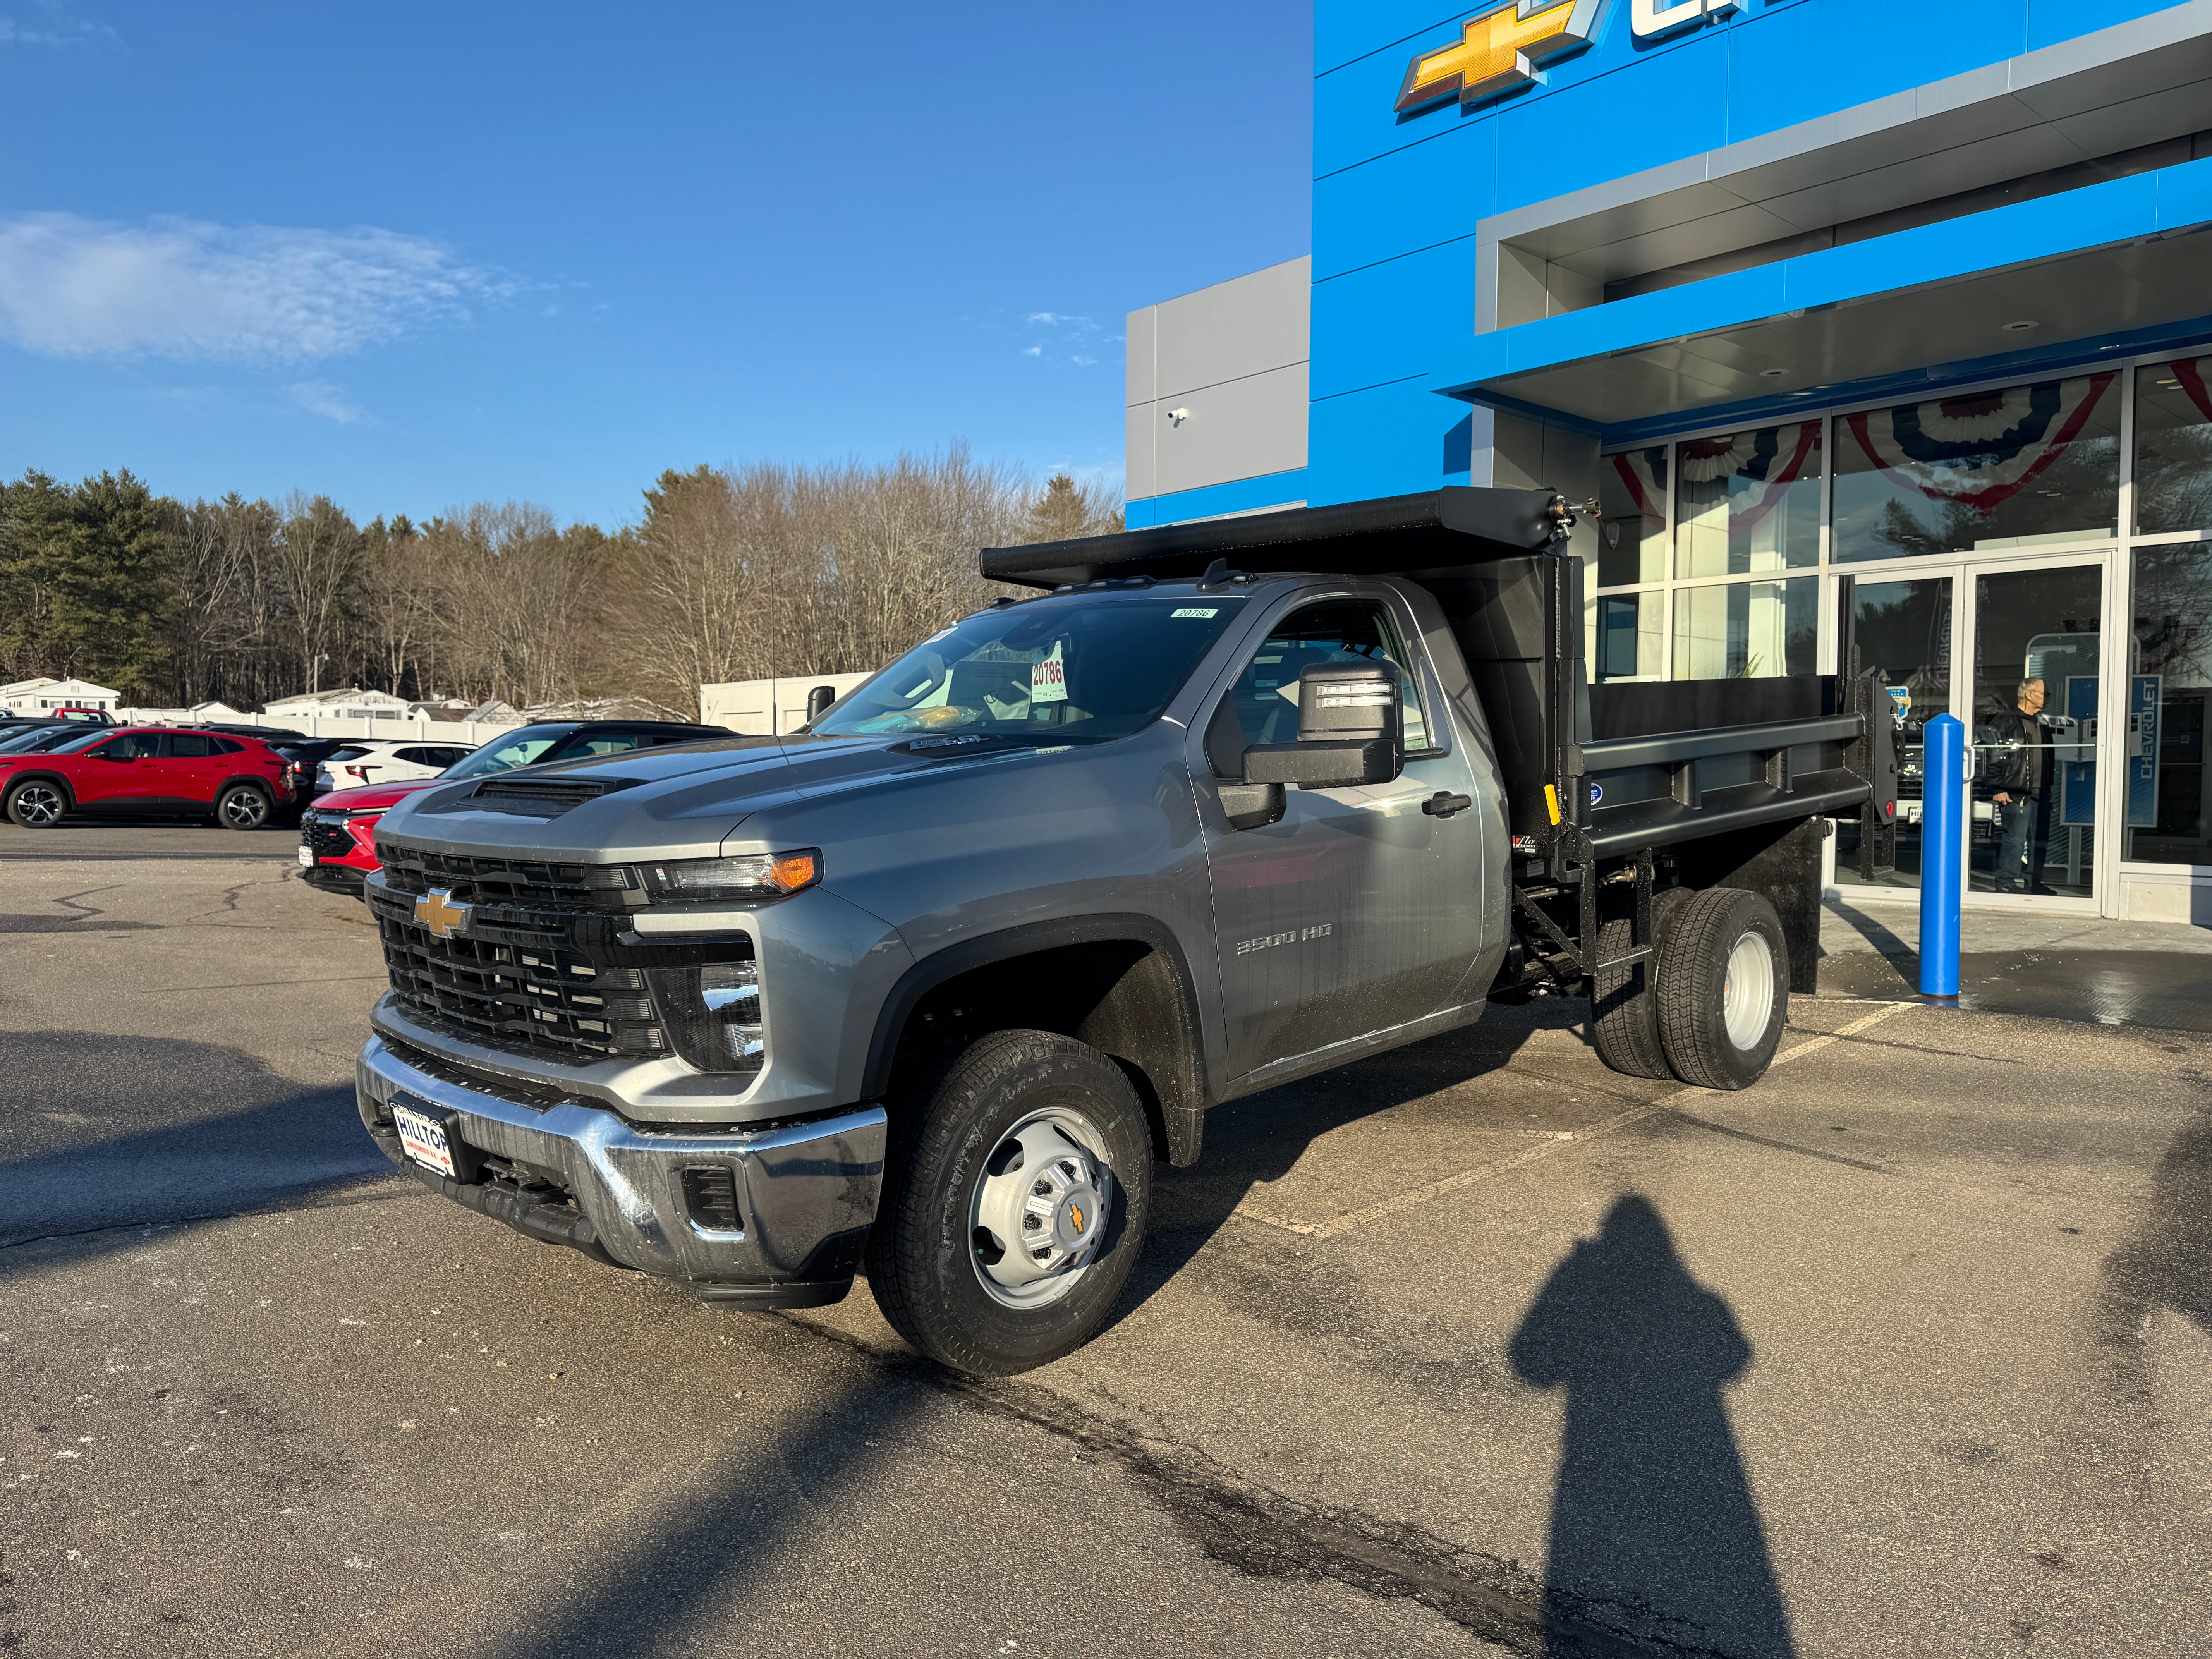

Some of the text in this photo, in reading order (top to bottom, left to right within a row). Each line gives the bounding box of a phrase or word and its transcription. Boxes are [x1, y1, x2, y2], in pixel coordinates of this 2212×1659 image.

[1034, 660, 1062, 685] 20786
[2141, 680, 2155, 779] CHEVROLET
[1512, 836, 1534, 845] irflo
[1237, 924, 1332, 955] 3500 HD
[397, 1115, 448, 1152] HILLTOP
